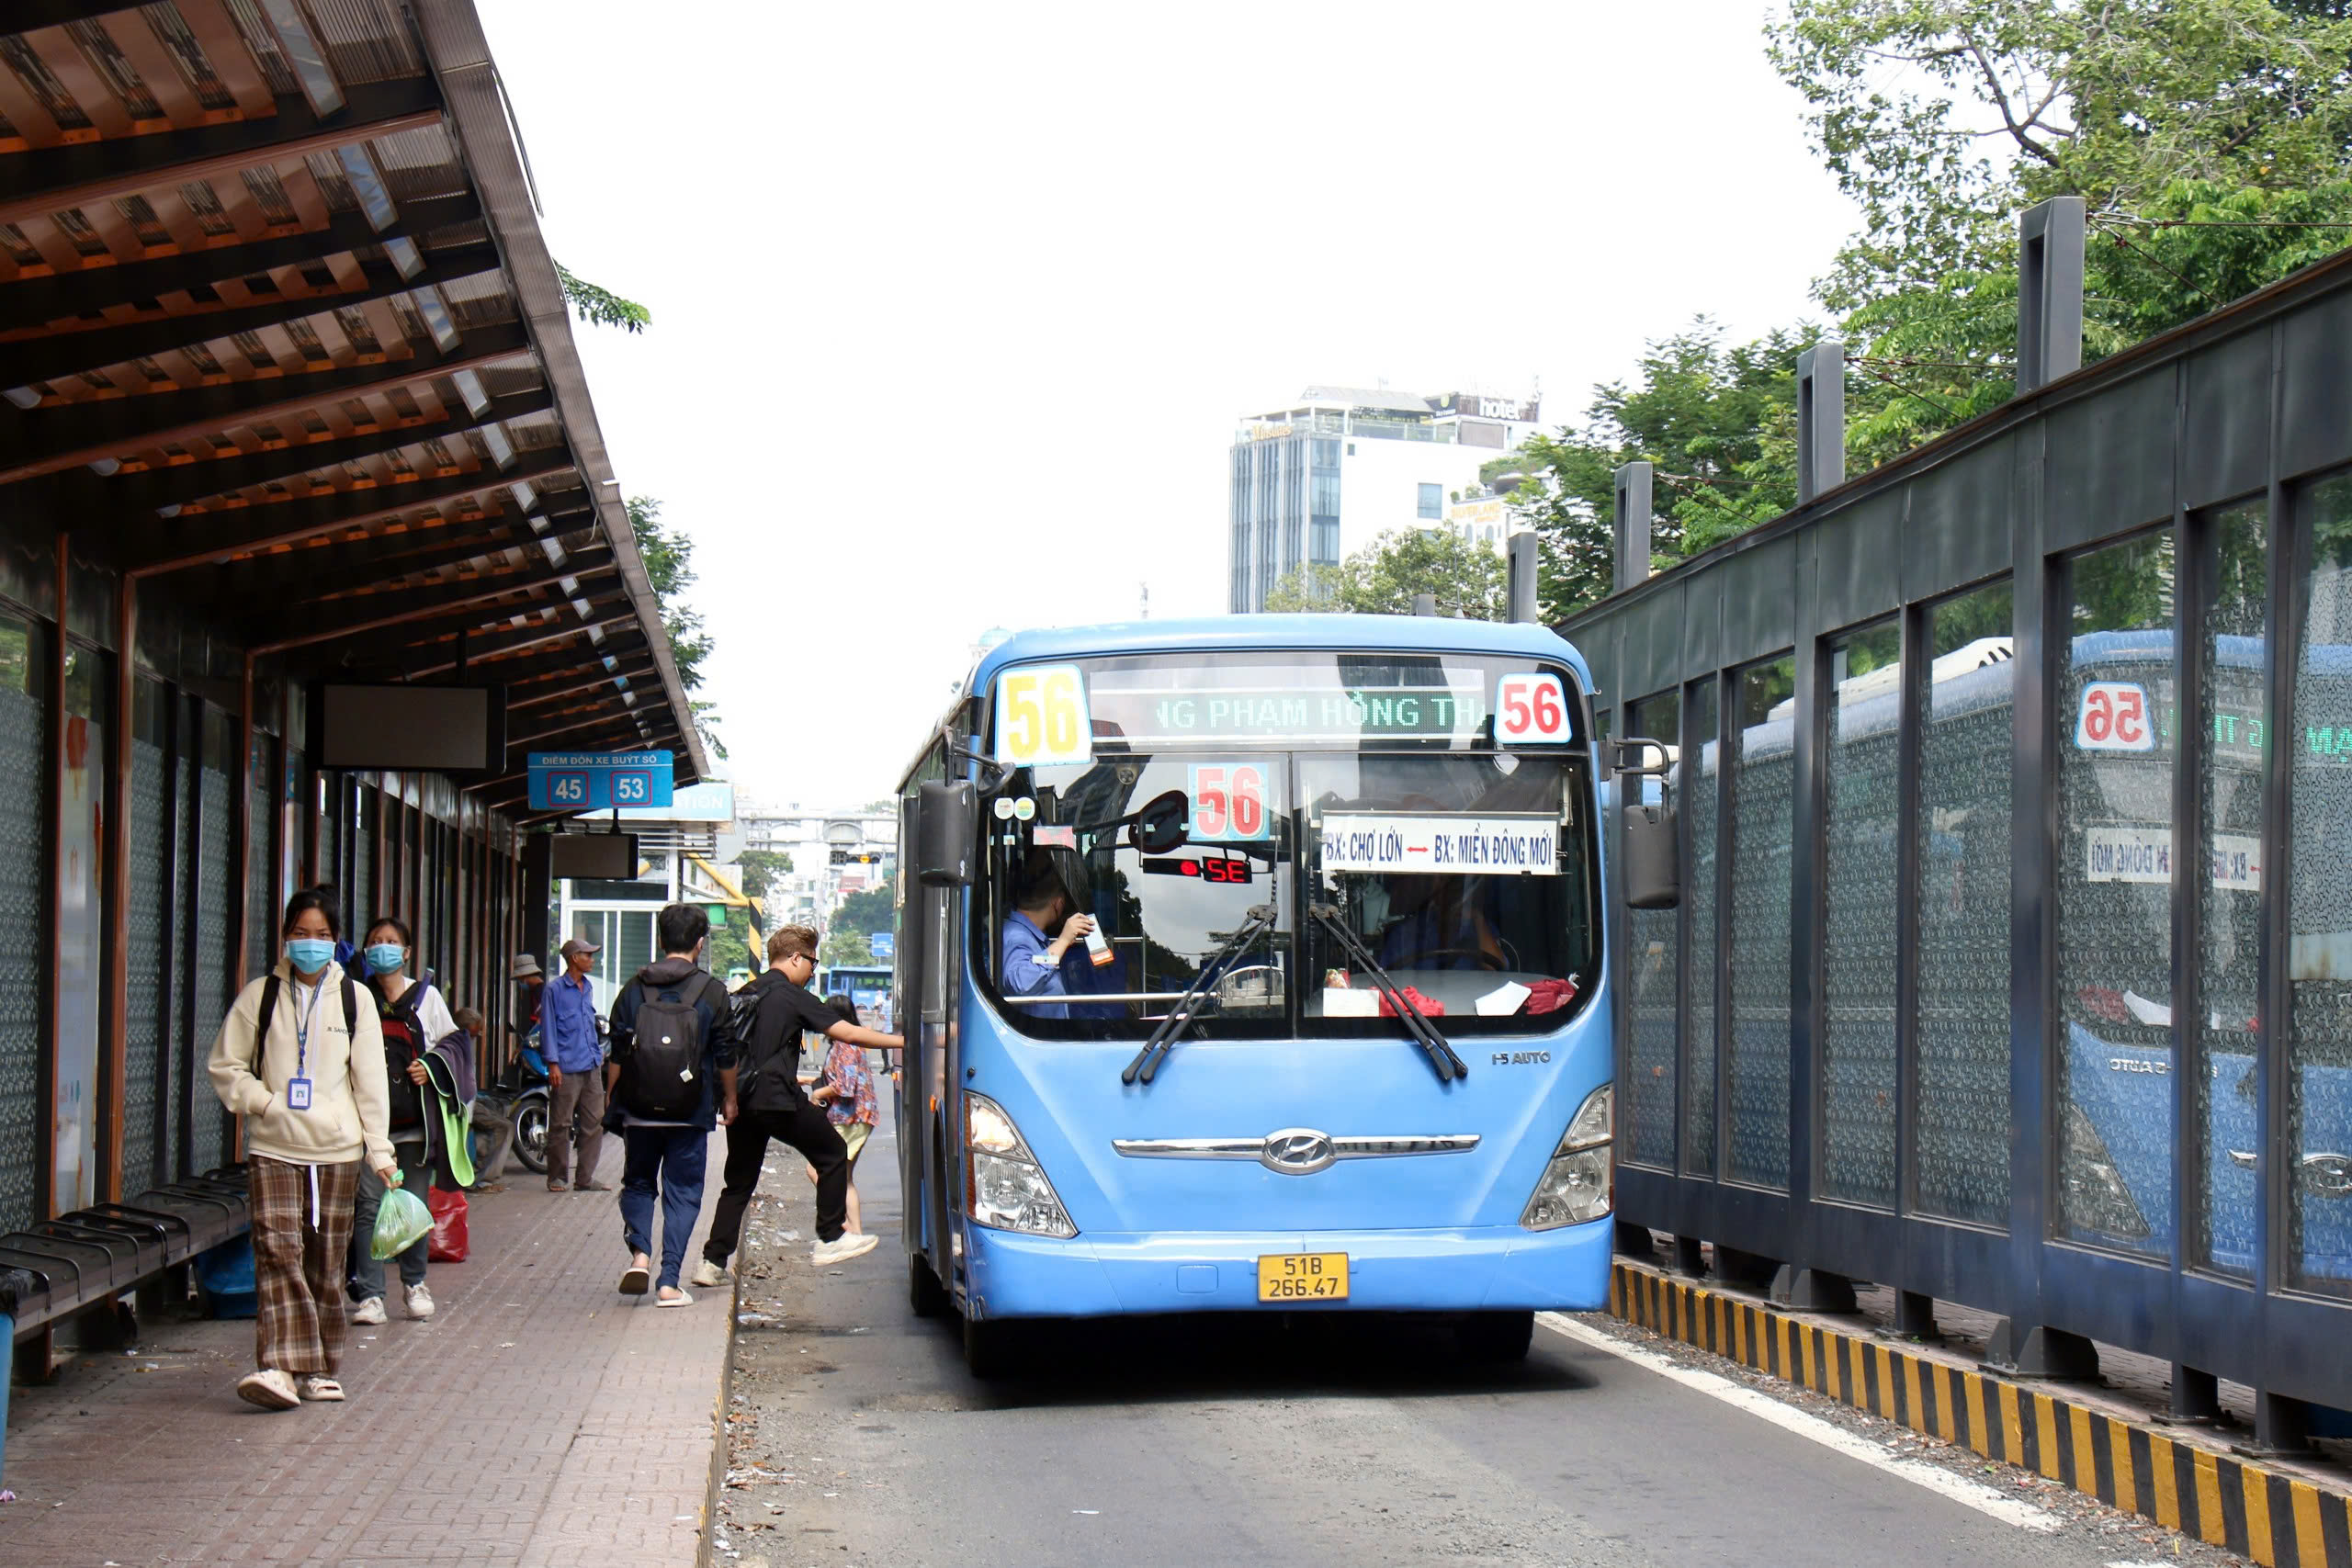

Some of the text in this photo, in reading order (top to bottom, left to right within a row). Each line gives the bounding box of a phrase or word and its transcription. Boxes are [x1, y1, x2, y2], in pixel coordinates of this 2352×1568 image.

[1479, 397, 1521, 420] hotel
[1006, 672, 1078, 758] 56
[1209, 698, 1308, 734] PHẠM
[1504, 682, 1561, 734] 56
[595, 756, 609, 764] XE
[612, 754, 639, 764] BUÝT
[555, 777, 644, 800] 45 53
[1196, 765, 1263, 837] 56
[1350, 829, 1376, 868] CHỢ
[1379, 825, 1403, 862] LỚN
[1434, 834, 1454, 863] BX:
[1458, 822, 1489, 864] MIỀN
[1492, 828, 1525, 865] ĐÔNG
[1529, 829, 1553, 865] MỚI
[1511, 1050, 1551, 1065] AUTO
[1283, 1257, 1322, 1276] 51B
[1269, 1277, 1339, 1297] 266.47
